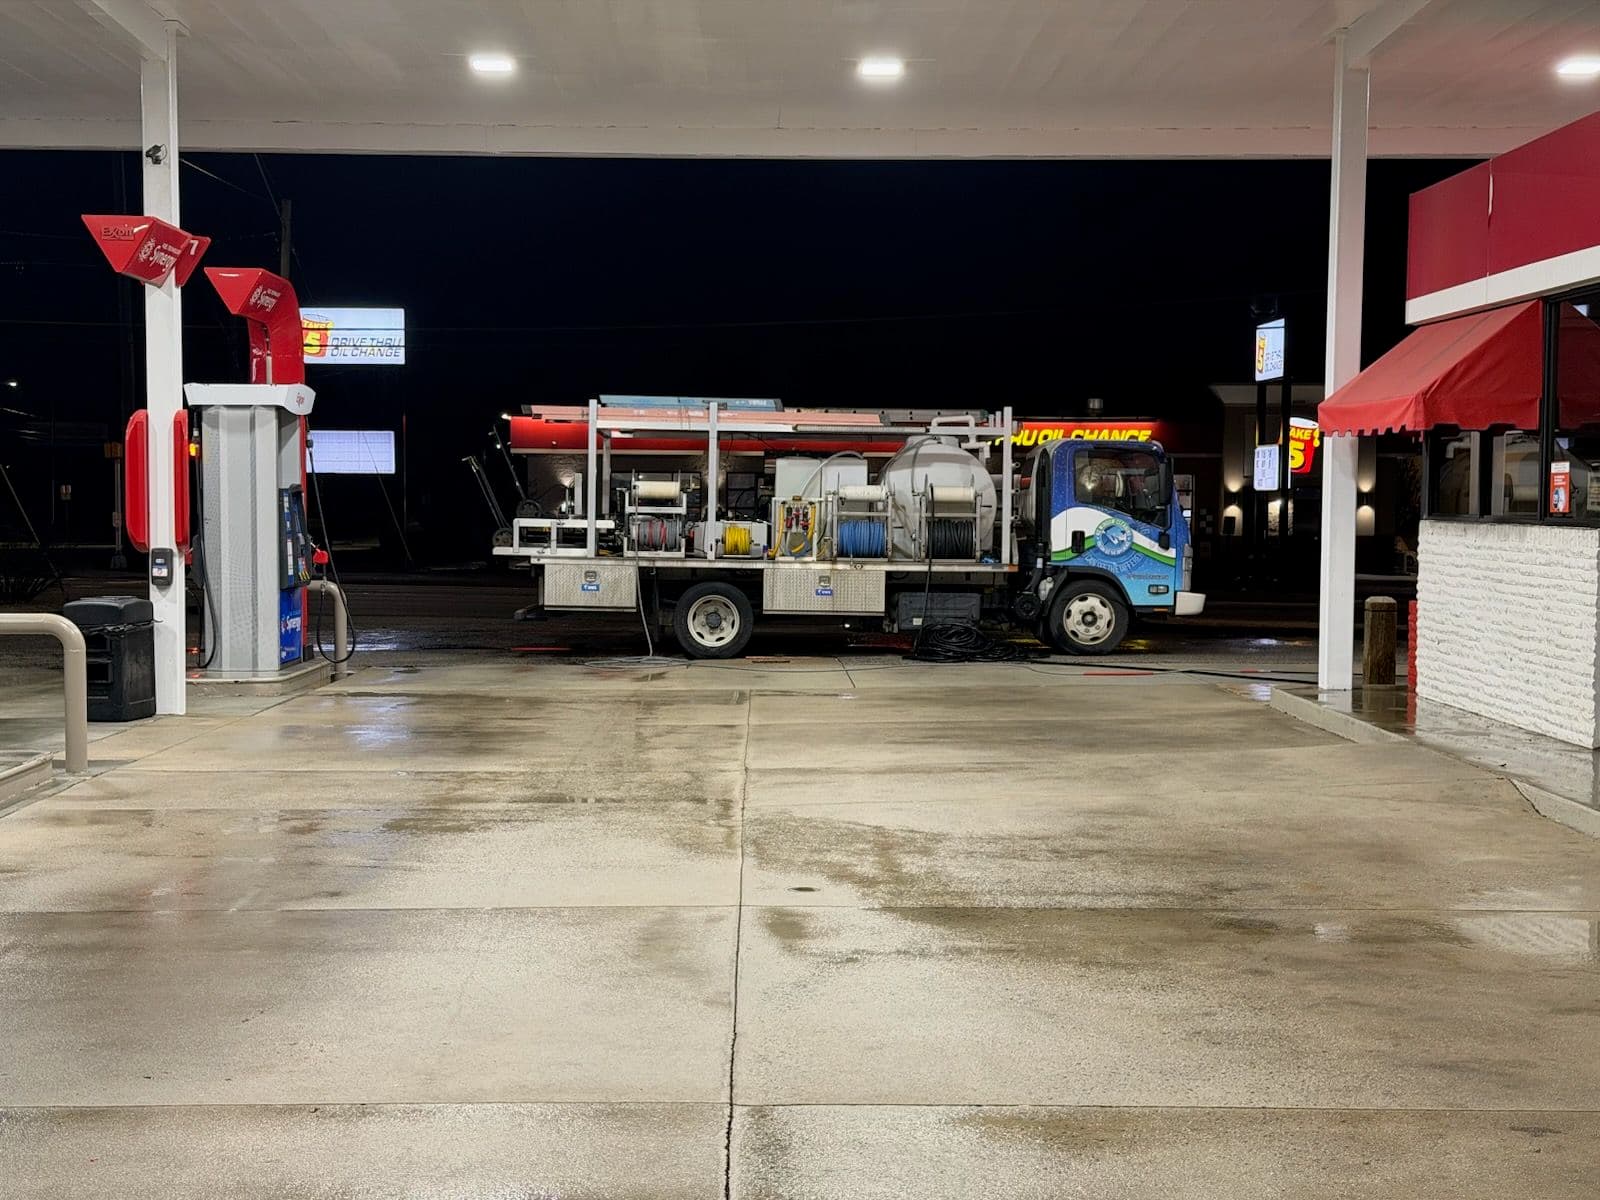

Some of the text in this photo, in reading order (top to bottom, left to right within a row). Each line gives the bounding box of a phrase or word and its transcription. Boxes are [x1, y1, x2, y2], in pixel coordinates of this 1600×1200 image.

[189, 239, 199, 255] 7
[304, 331, 321, 354] 5
[331, 337, 402, 347] DRIVE THRU
[330, 347, 401, 357] OIL CHANGE
[1290, 427, 1313, 440] AKE
[1289, 440, 1304, 469] 5
